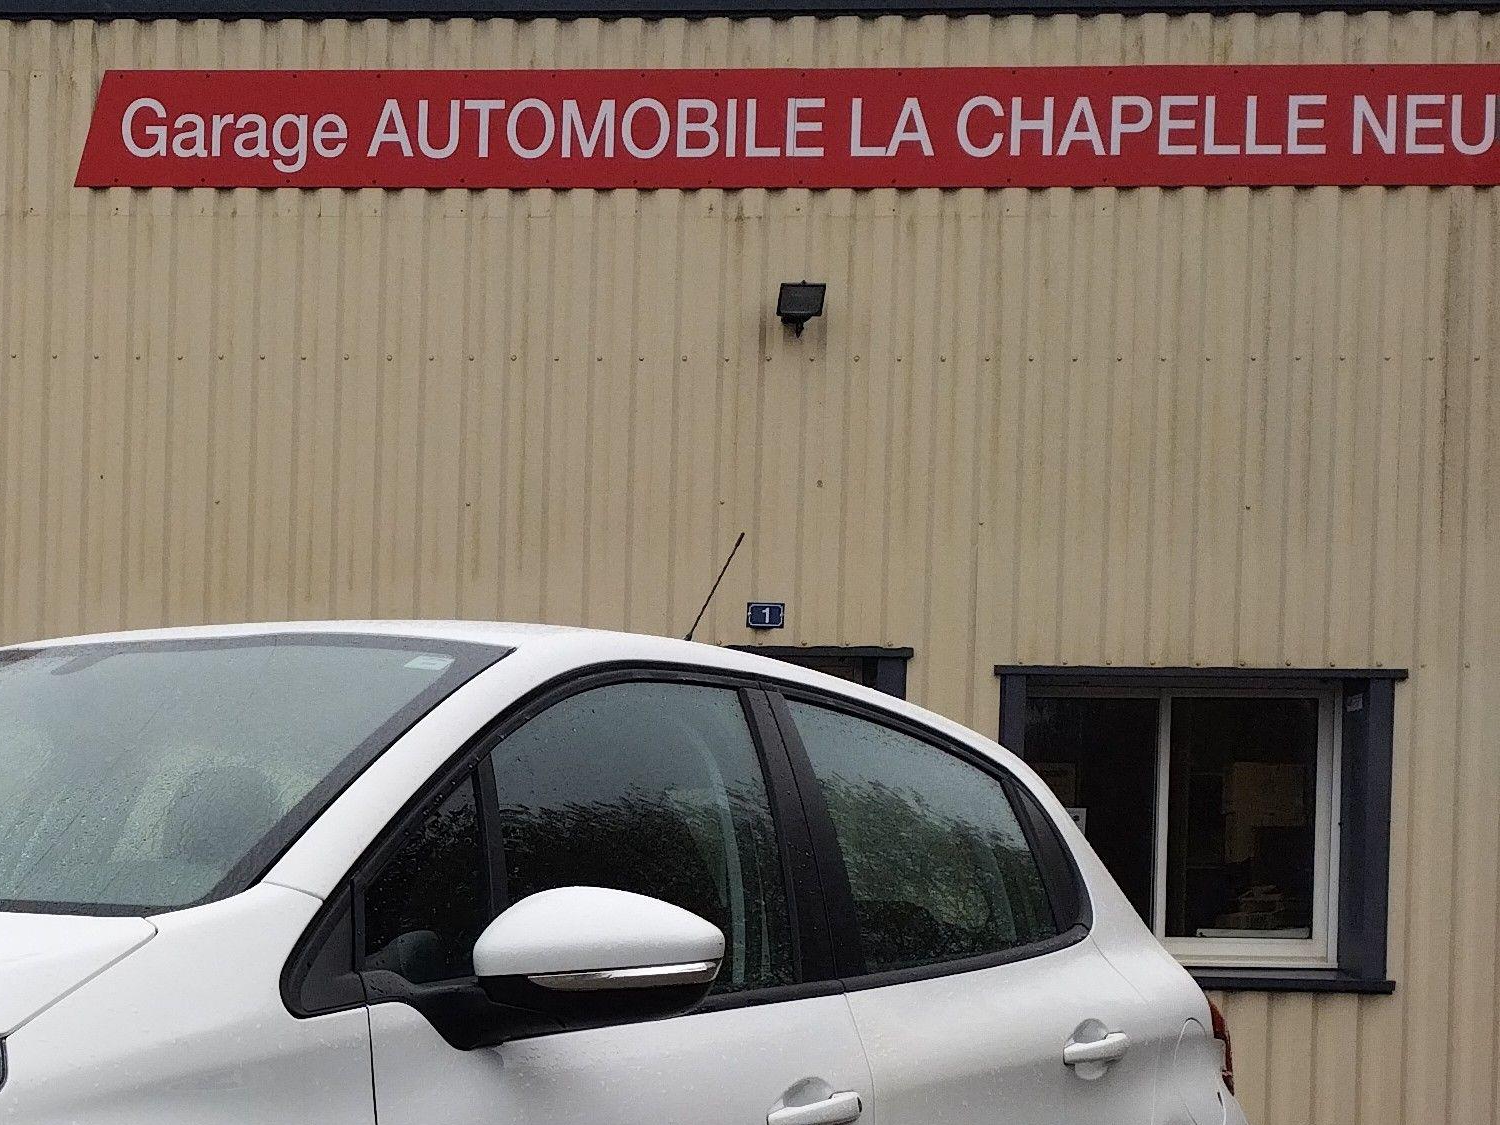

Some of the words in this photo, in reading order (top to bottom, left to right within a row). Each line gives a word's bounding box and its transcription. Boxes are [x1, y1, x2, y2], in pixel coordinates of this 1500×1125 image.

[121, 97, 348, 173] Garage
[366, 97, 826, 159] AUTOMOBILE
[850, 97, 935, 158] LA
[956, 94, 1328, 158] CHAPELLE
[1351, 94, 1497, 156] NEU
[761, 607, 770, 624] 1
